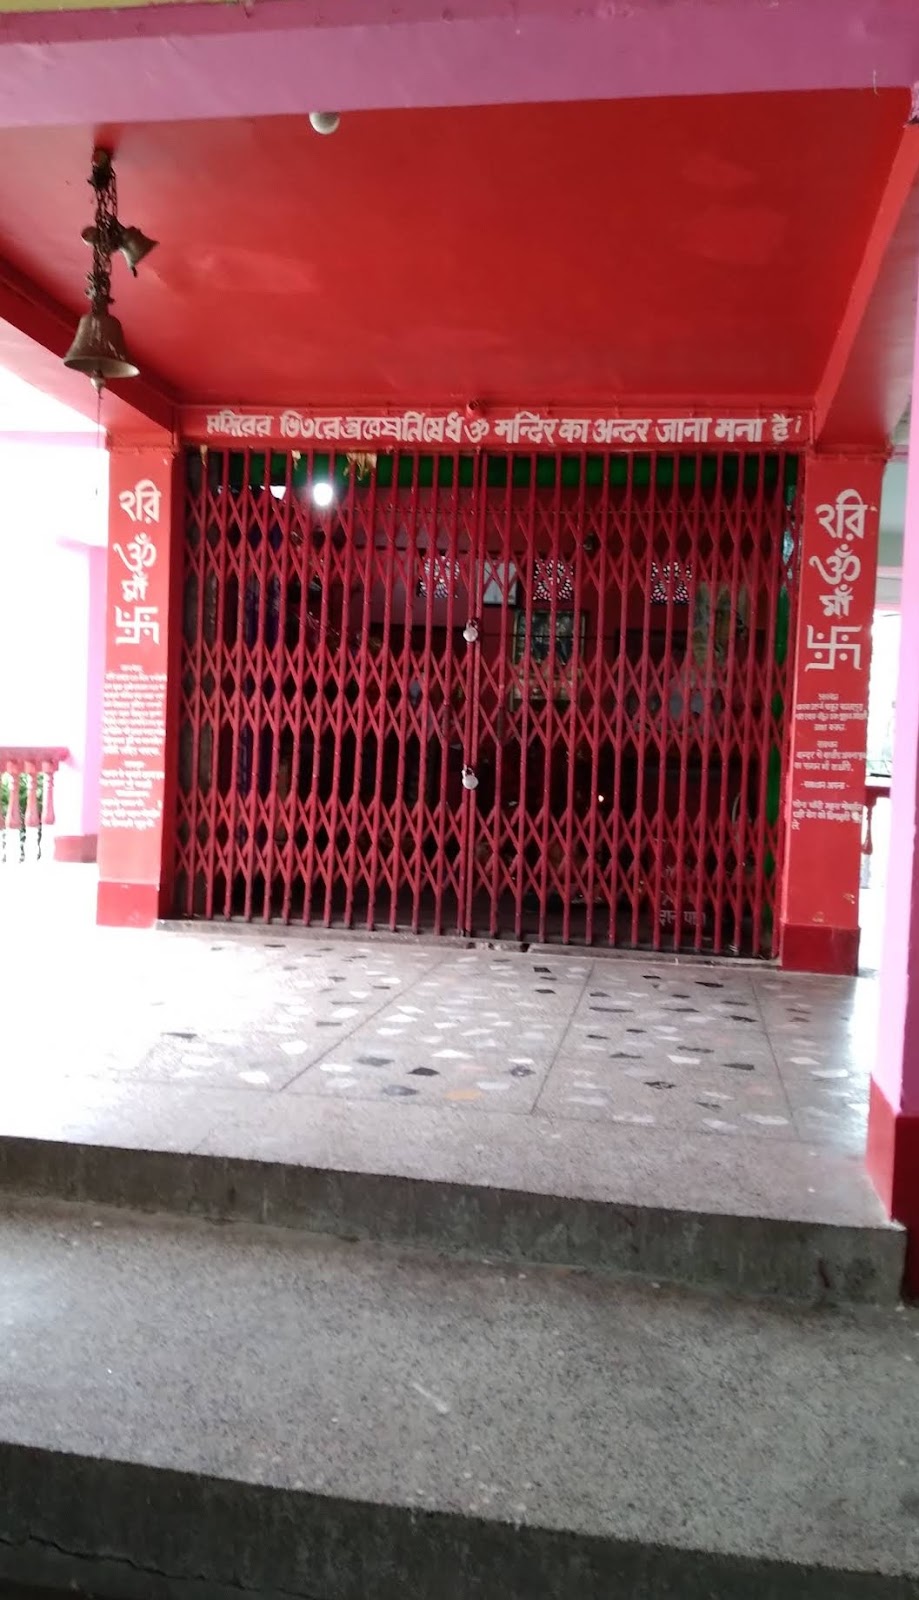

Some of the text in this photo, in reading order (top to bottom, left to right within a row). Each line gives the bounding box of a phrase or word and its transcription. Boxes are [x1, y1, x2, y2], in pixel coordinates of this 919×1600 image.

[280, 410, 342, 440] ভিতরে
[494, 410, 559, 445] मन्दिर
[559, 418, 592, 443] का
[592, 418, 652, 443] अन्दर
[655, 416, 712, 443] जाना
[715, 416, 767, 443] मना
